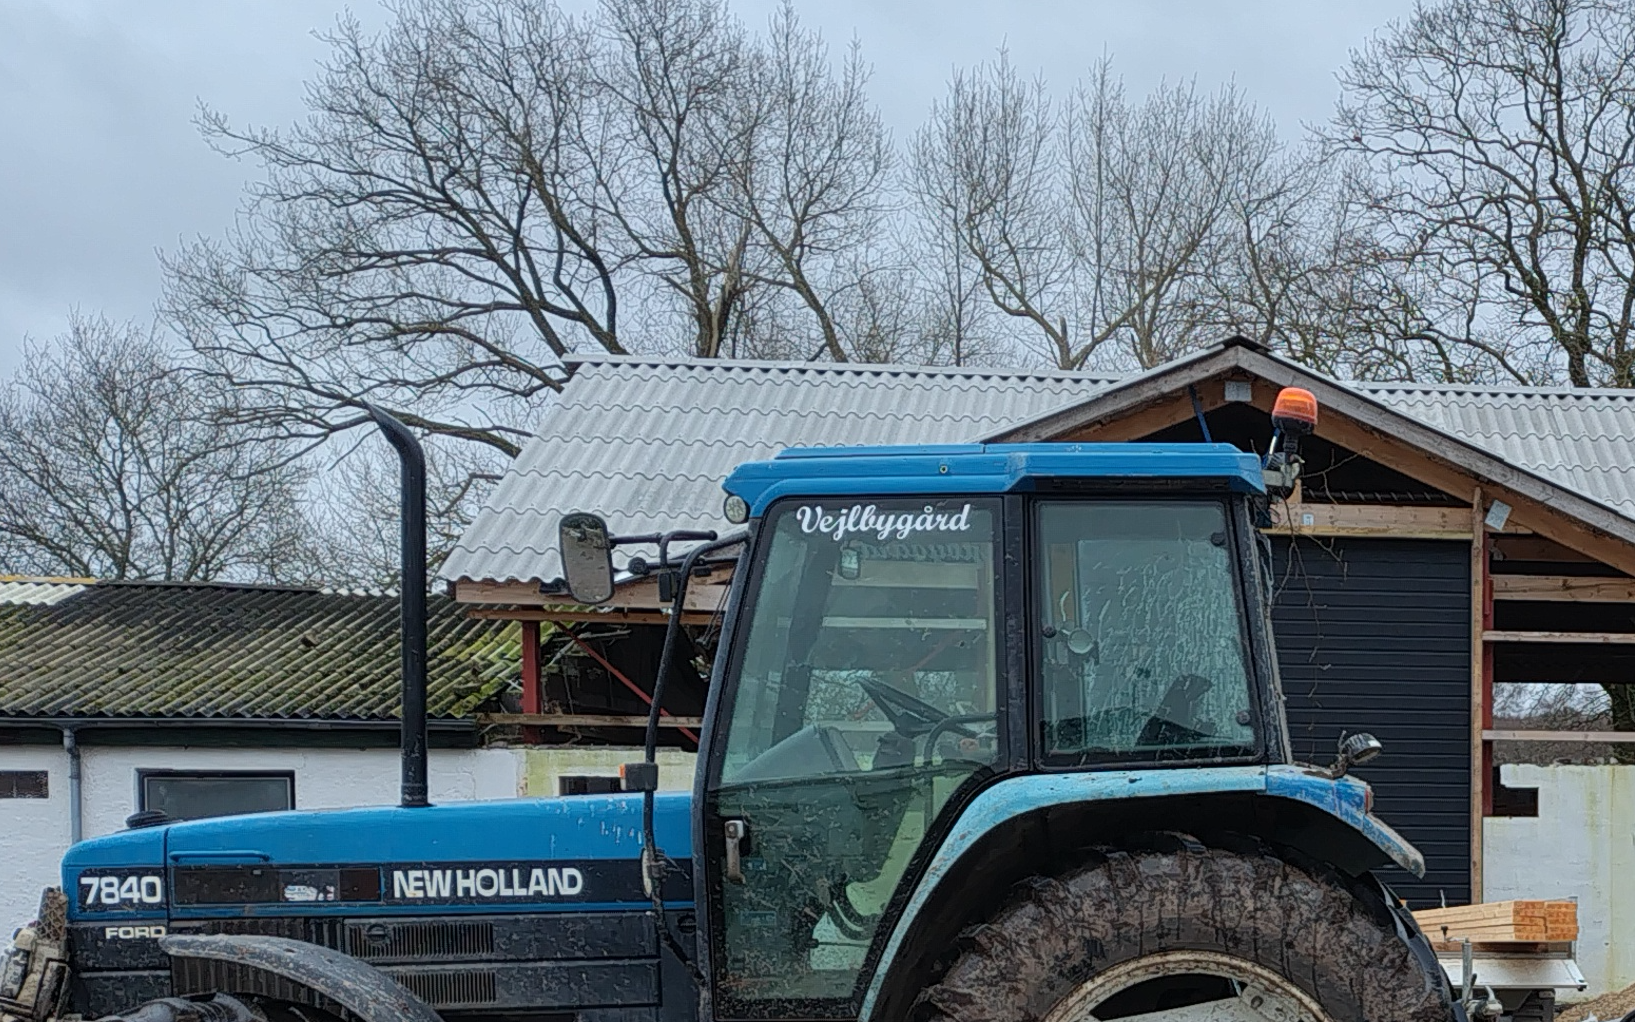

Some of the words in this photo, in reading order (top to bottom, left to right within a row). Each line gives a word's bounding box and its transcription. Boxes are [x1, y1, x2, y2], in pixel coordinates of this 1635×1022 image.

[796, 504, 971, 541] Vejlbygård
[80, 875, 162, 905] 7840
[393, 868, 452, 898] NEW
[457, 867, 583, 898] HOLLAND
[105, 925, 167, 939] FORD
